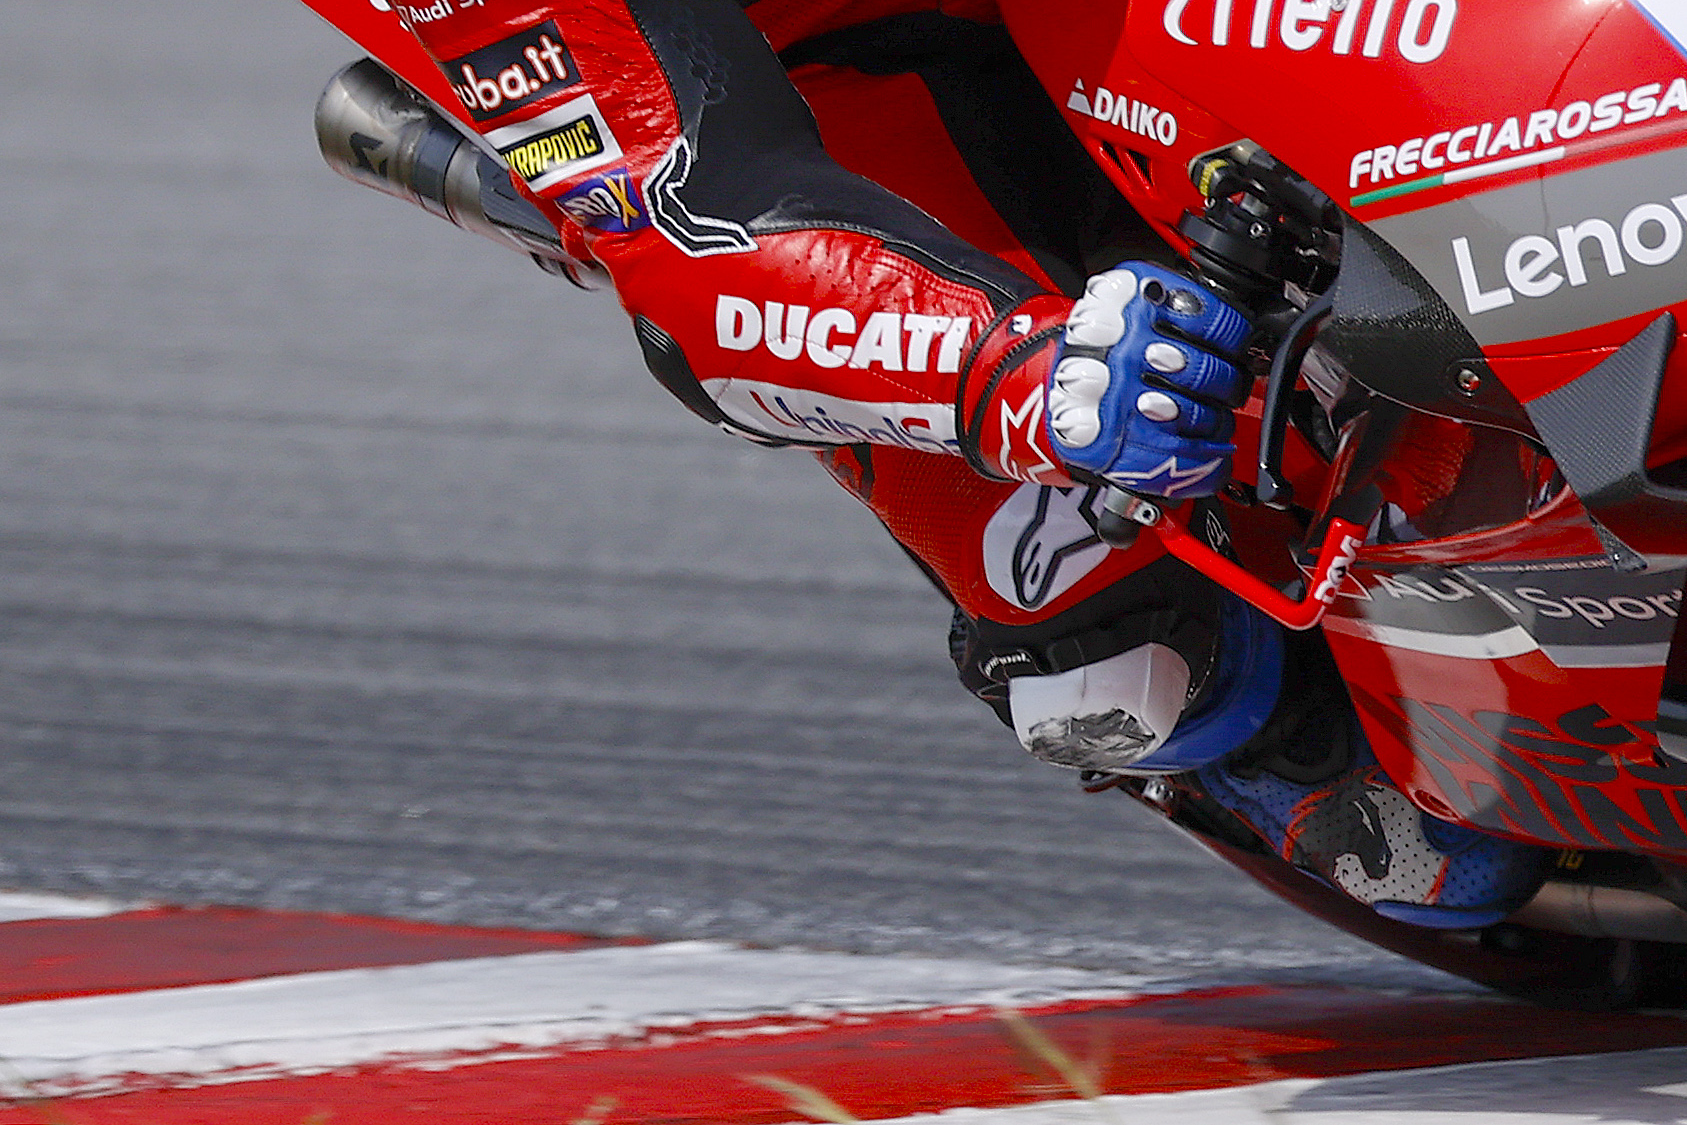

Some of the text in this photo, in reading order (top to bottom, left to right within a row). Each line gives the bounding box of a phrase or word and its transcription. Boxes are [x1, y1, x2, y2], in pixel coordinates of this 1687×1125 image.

[453, 34, 567, 111] uba.it
[1094, 86, 1178, 146] DAIKO
[716, 294, 973, 374] DUCATI
